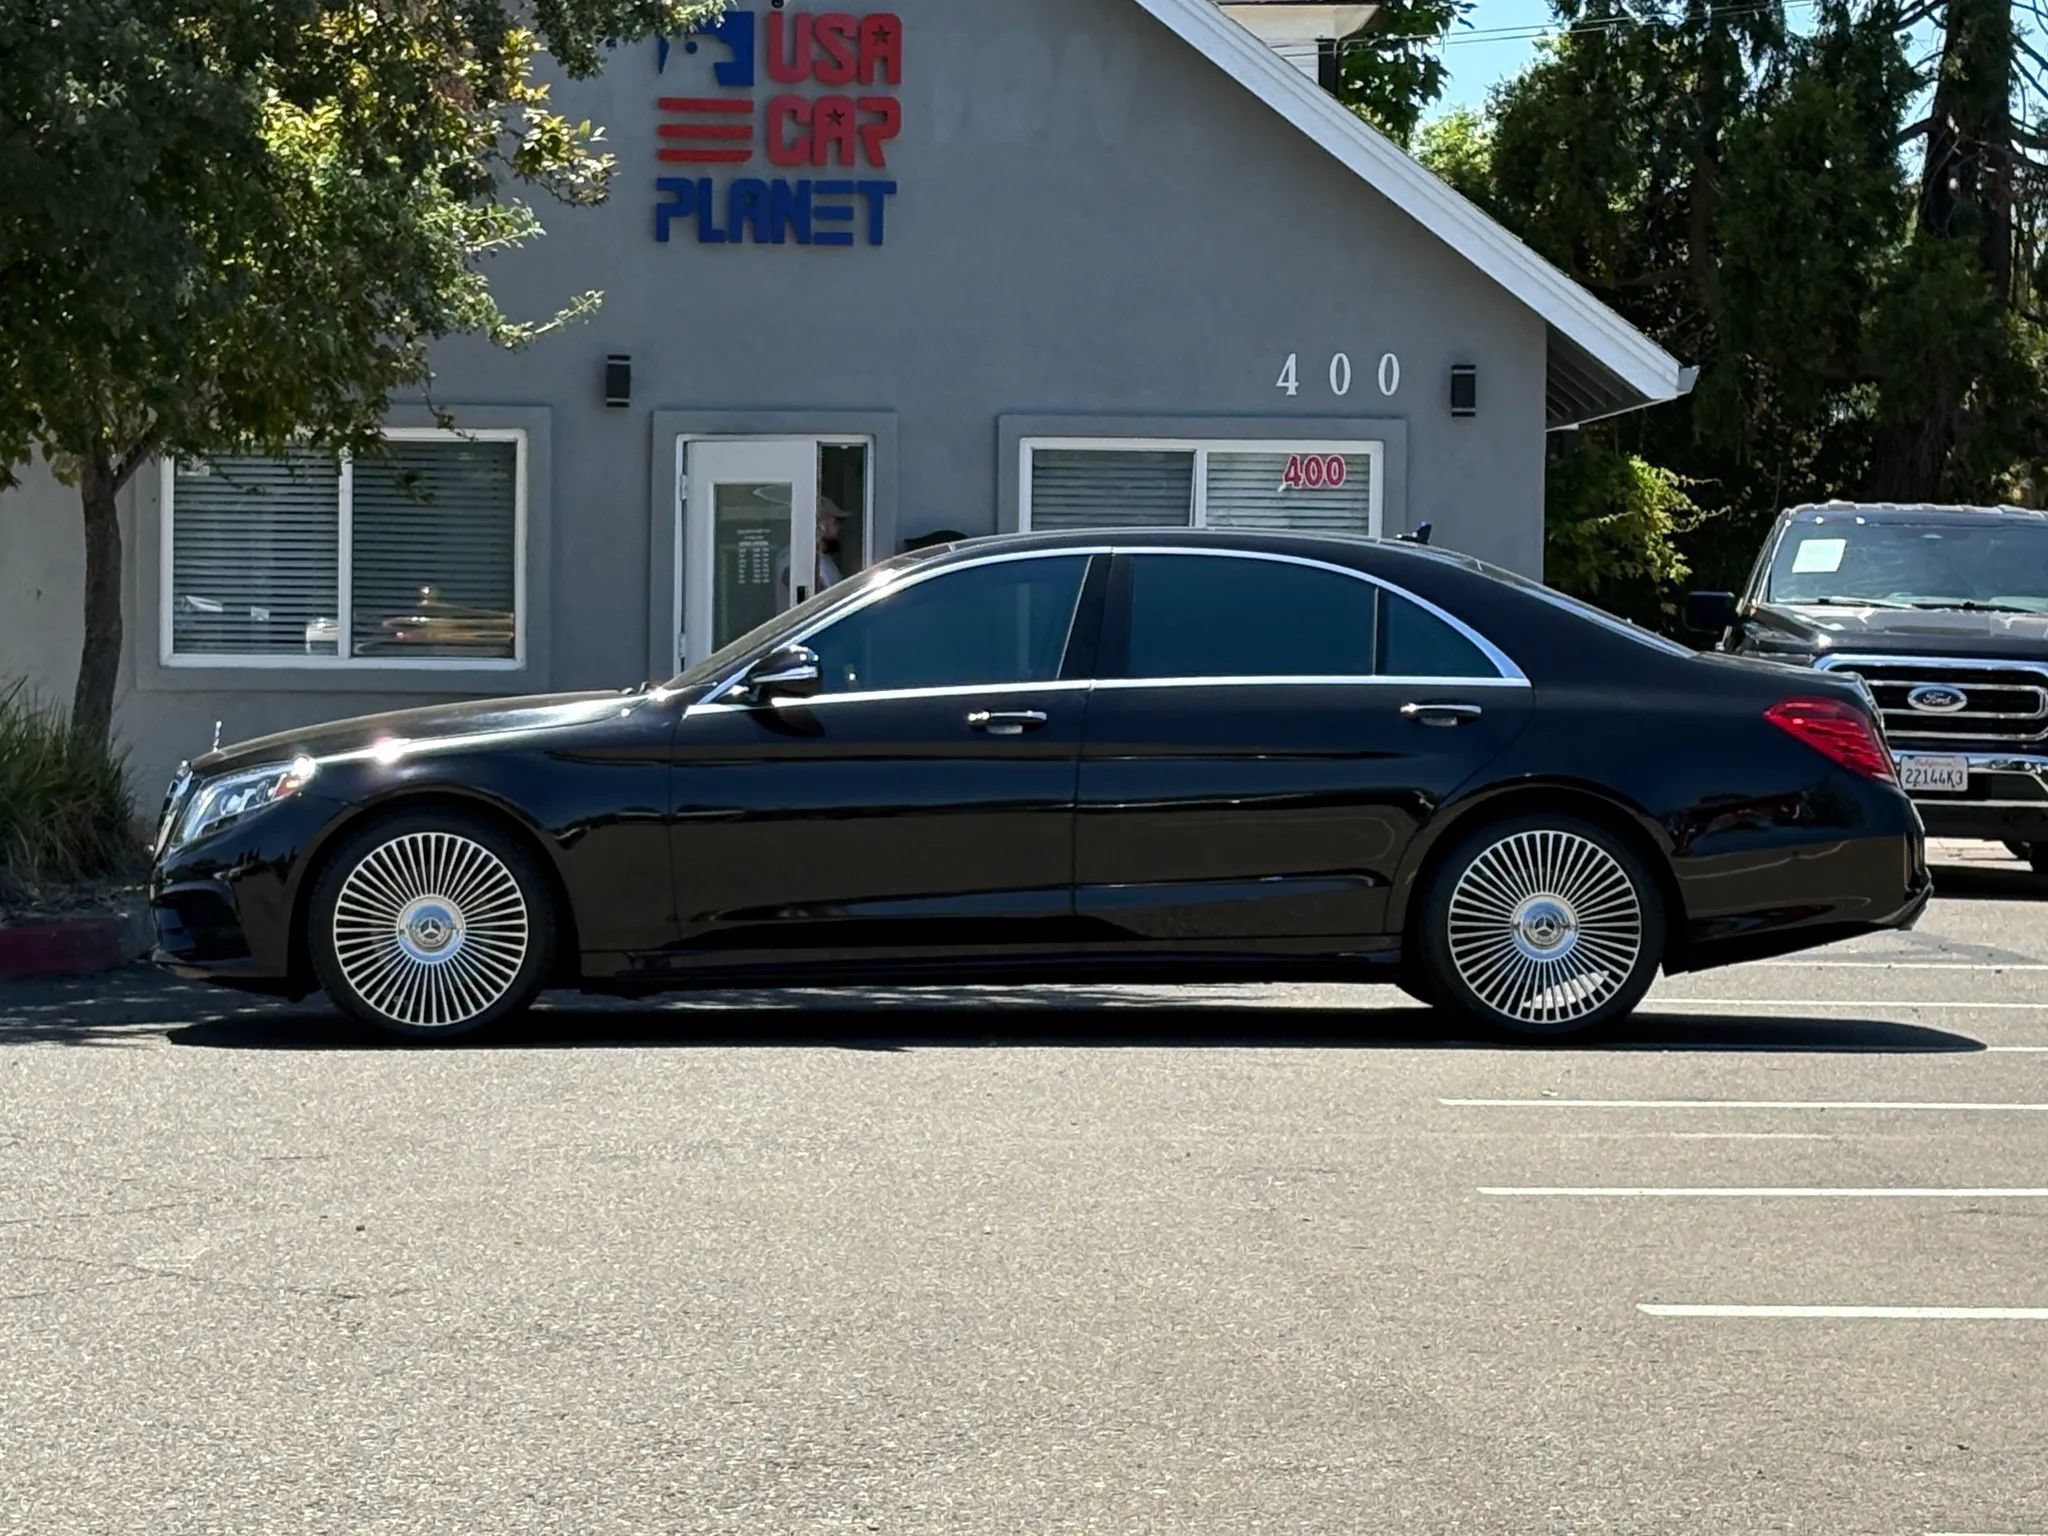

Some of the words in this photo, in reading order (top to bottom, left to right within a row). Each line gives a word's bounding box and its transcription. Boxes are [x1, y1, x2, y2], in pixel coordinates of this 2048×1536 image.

[767, 11, 902, 85] USA
[767, 95, 902, 168] CAR
[656, 177, 897, 246] PLANET
[1283, 455, 1346, 488] 400
[1922, 691, 1952, 705] Ford
[1905, 769, 1963, 787] 22144K3
